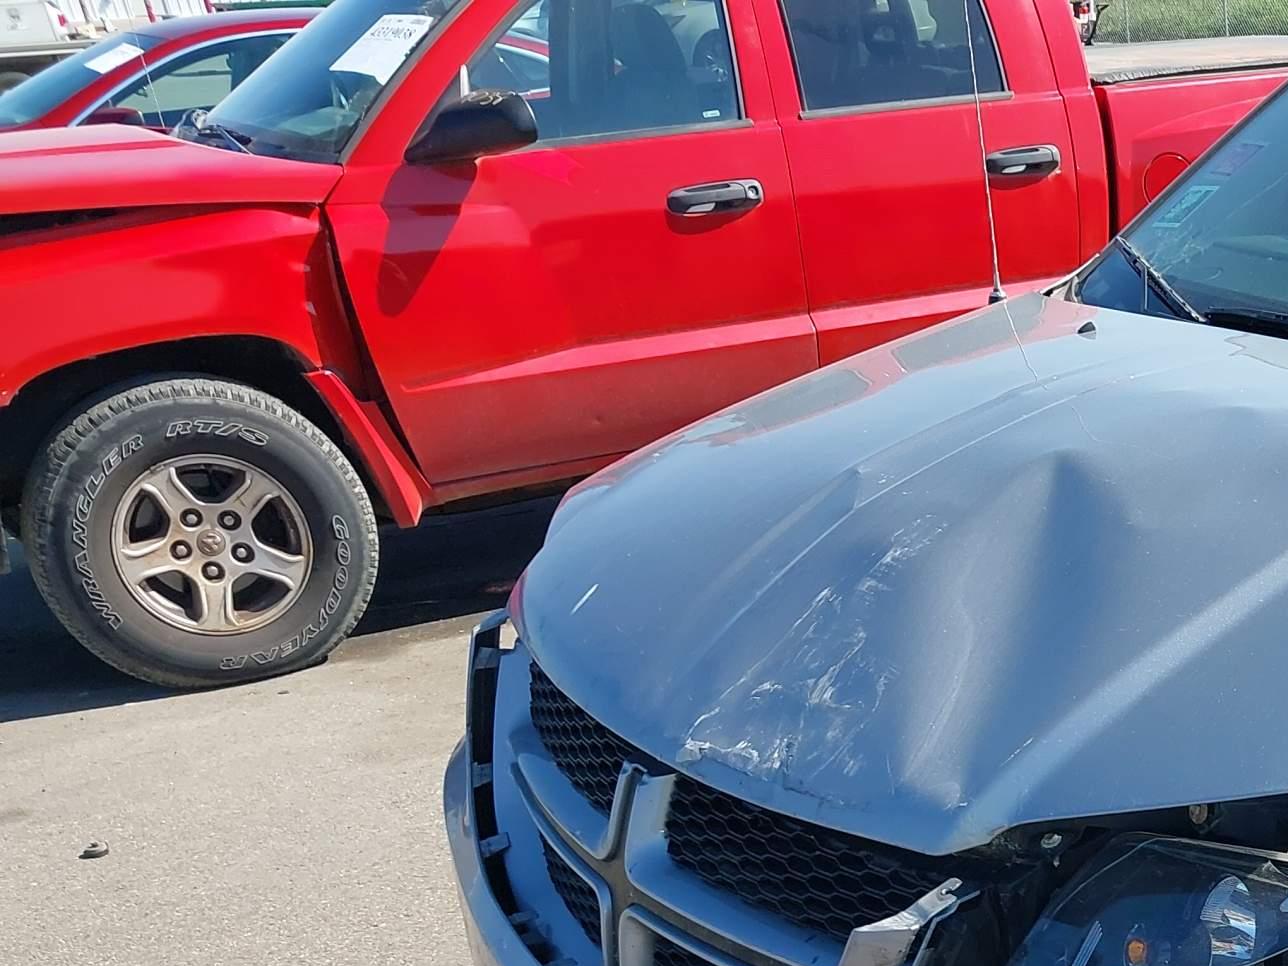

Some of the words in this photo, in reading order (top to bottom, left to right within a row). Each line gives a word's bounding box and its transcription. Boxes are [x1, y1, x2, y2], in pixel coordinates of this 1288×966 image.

[72, 434, 144, 631] WRANGLER
[166, 420, 270, 446] RT/S
[219, 514, 351, 671] GOODYEAR
